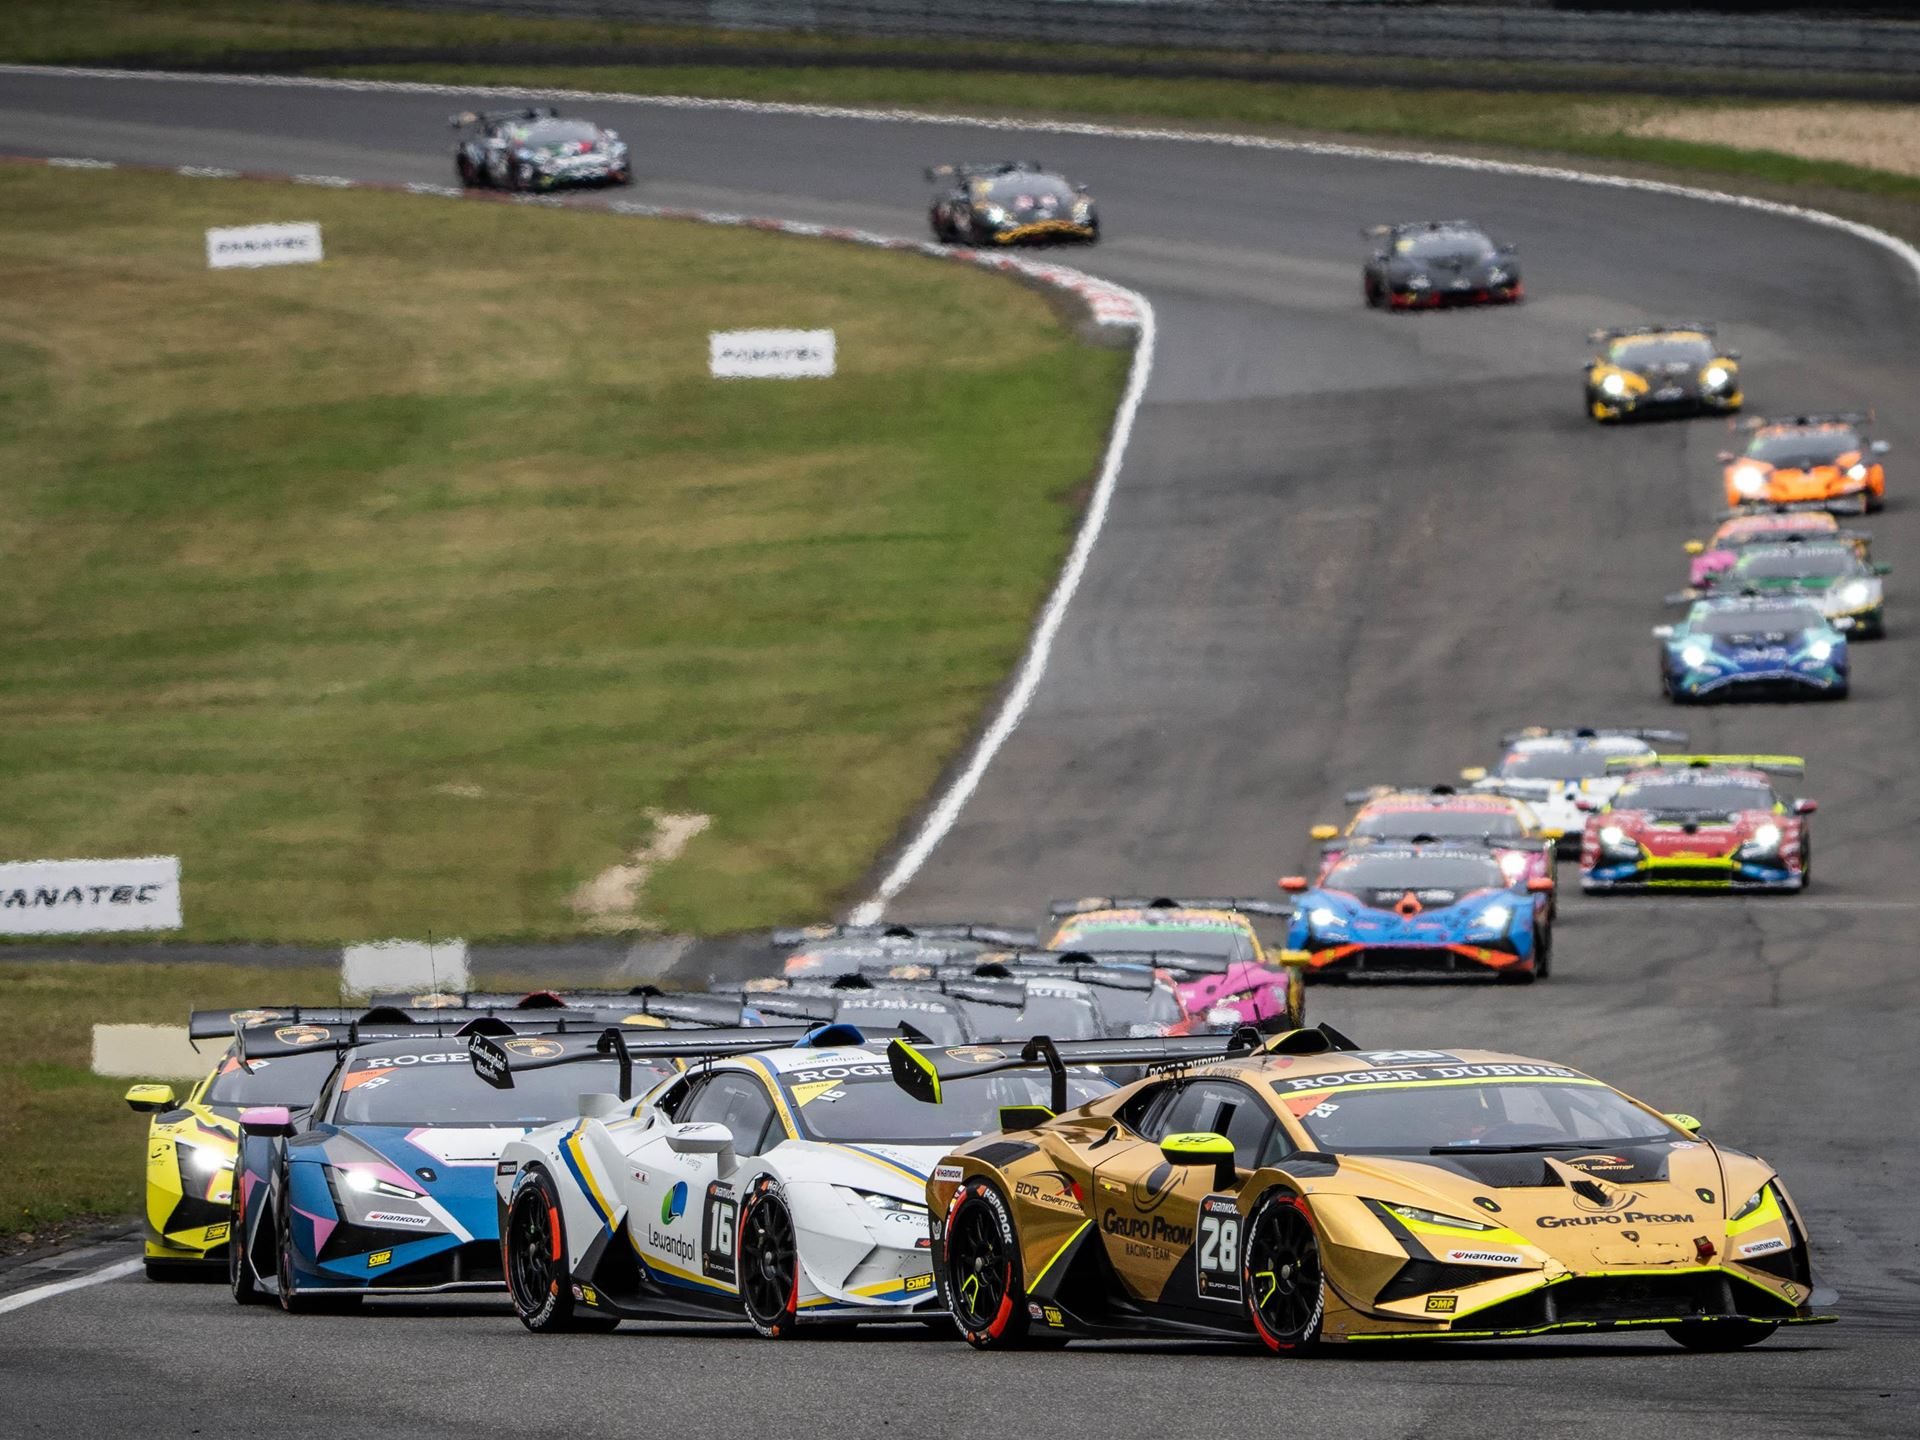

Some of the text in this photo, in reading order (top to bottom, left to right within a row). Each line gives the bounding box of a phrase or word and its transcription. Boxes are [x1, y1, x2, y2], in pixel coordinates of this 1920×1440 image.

[0, 884, 163, 908] ANATEC
[366, 1053, 470, 1069] ROGE
[794, 1065, 893, 1082] ROGE
[1287, 1064, 1575, 1090] ROGER DUBUIS
[817, 1089, 846, 1102] 16
[1307, 1103, 1340, 1118] 28
[1015, 1182, 1085, 1211] BDR COMPETITION
[710, 1201, 734, 1256] 16
[1103, 1207, 1193, 1246] GRUPO PROM
[1536, 1212, 1695, 1229] GRUPO PROM
[648, 1223, 696, 1263] Lewandpol
[1201, 1216, 1238, 1272] 28
[369, 1253, 391, 1264] OMP
[1125, 1243, 1170, 1262] RACING TEAM
[906, 1276, 931, 1289] OMP
[1428, 1300, 1455, 1309] OMP
[1045, 1310, 1062, 1323] OMP
